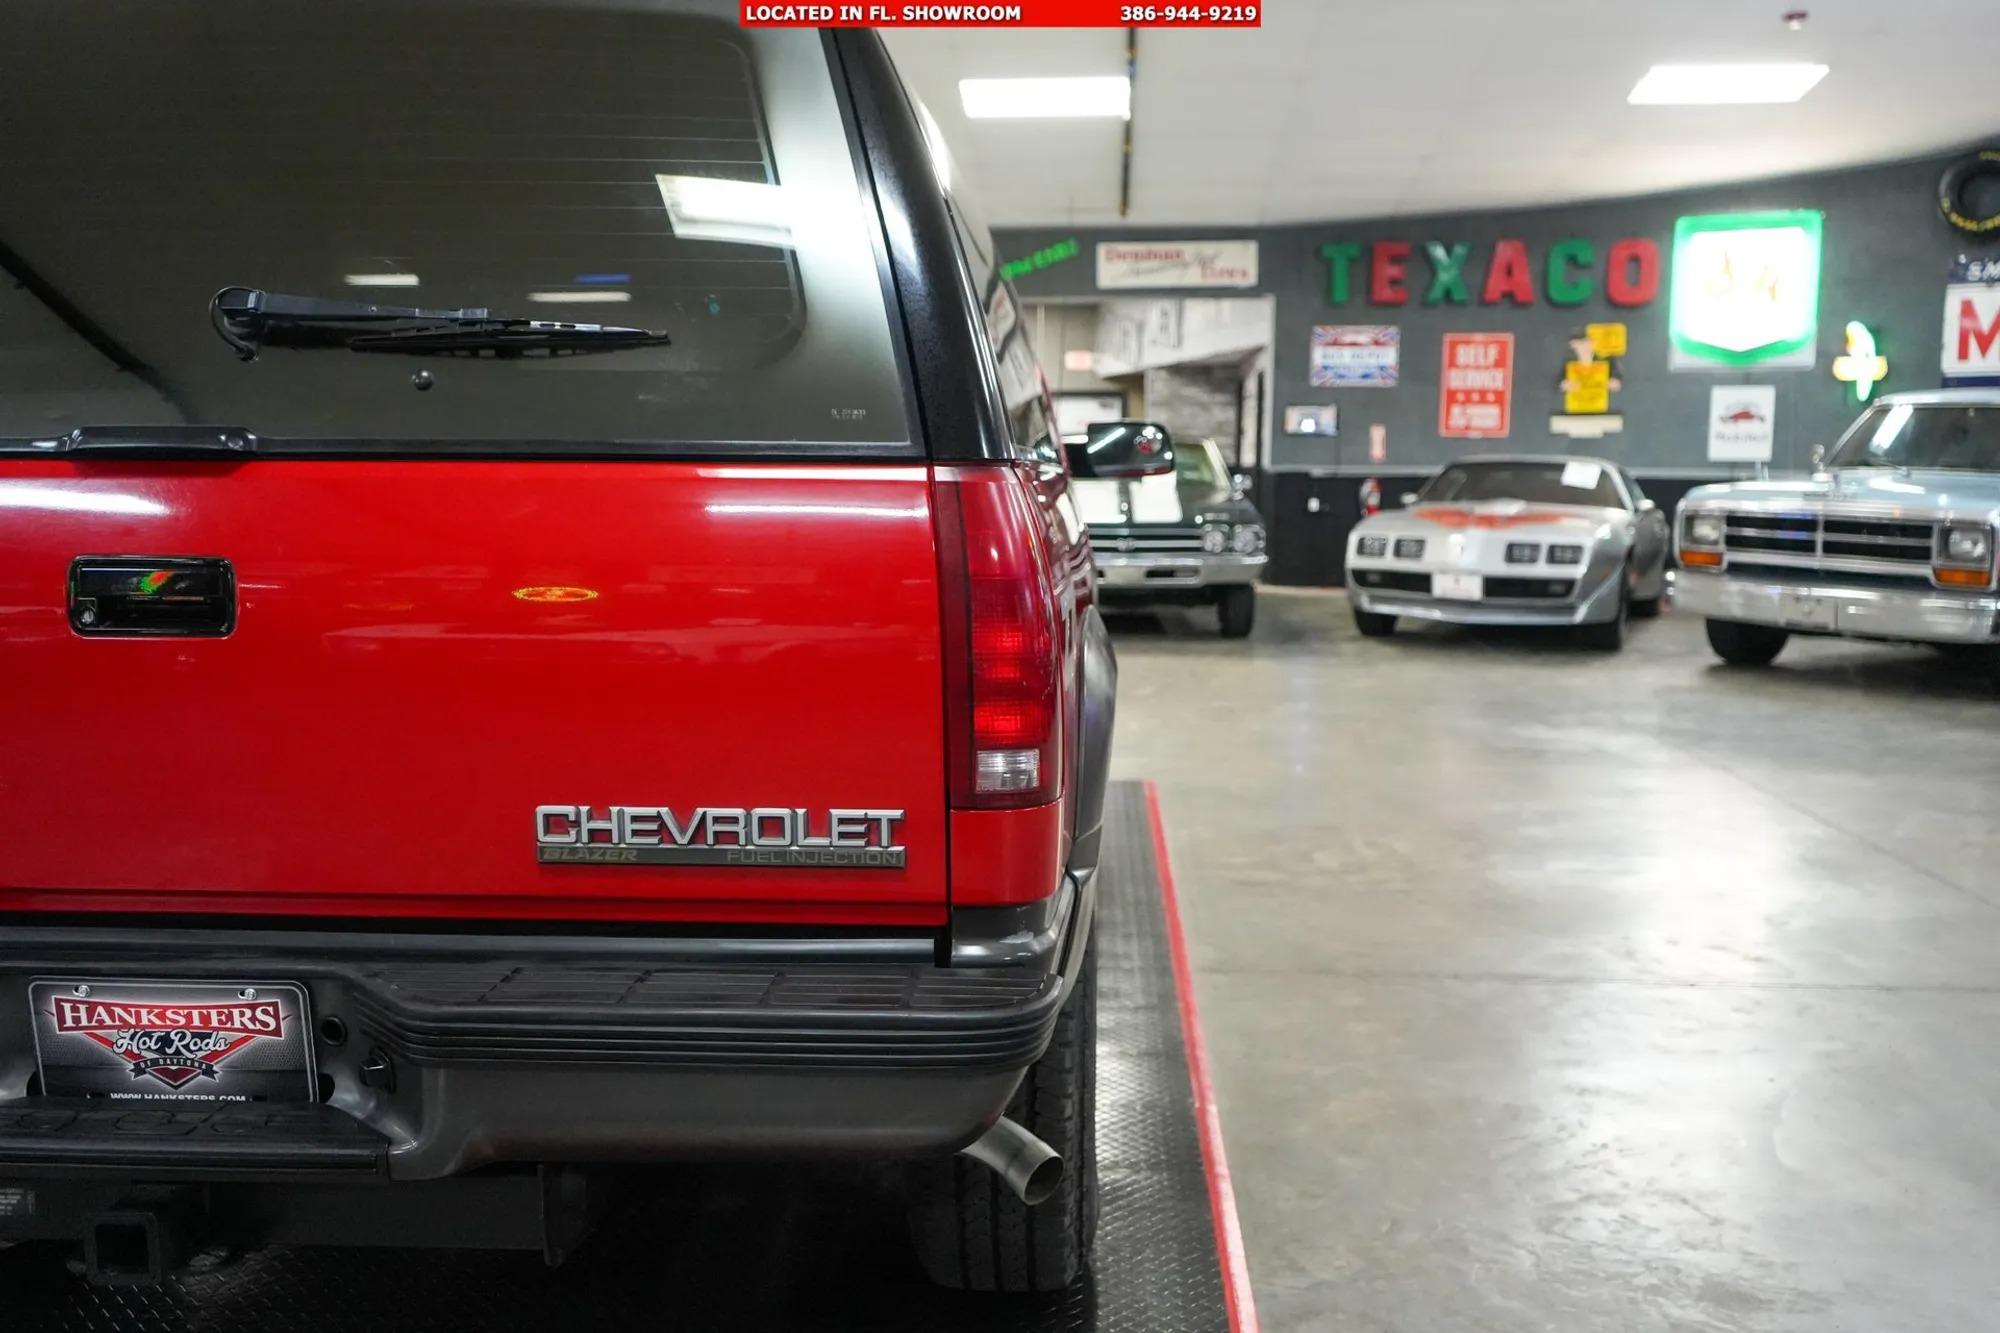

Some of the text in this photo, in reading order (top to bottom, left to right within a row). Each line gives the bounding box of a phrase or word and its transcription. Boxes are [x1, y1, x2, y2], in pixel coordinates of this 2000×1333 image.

[1320, 238, 1660, 307] TEXACO
[1455, 343, 1499, 367] SELF
[535, 804, 905, 848] CHEVROLET
[543, 848, 900, 865] BLAZER FUEL INJECTION
[60, 1001, 277, 1032] HANKSTERS
[112, 1028, 231, 1059] Hot Rods
[140, 1057, 208, 1070] OF DAYTONA
